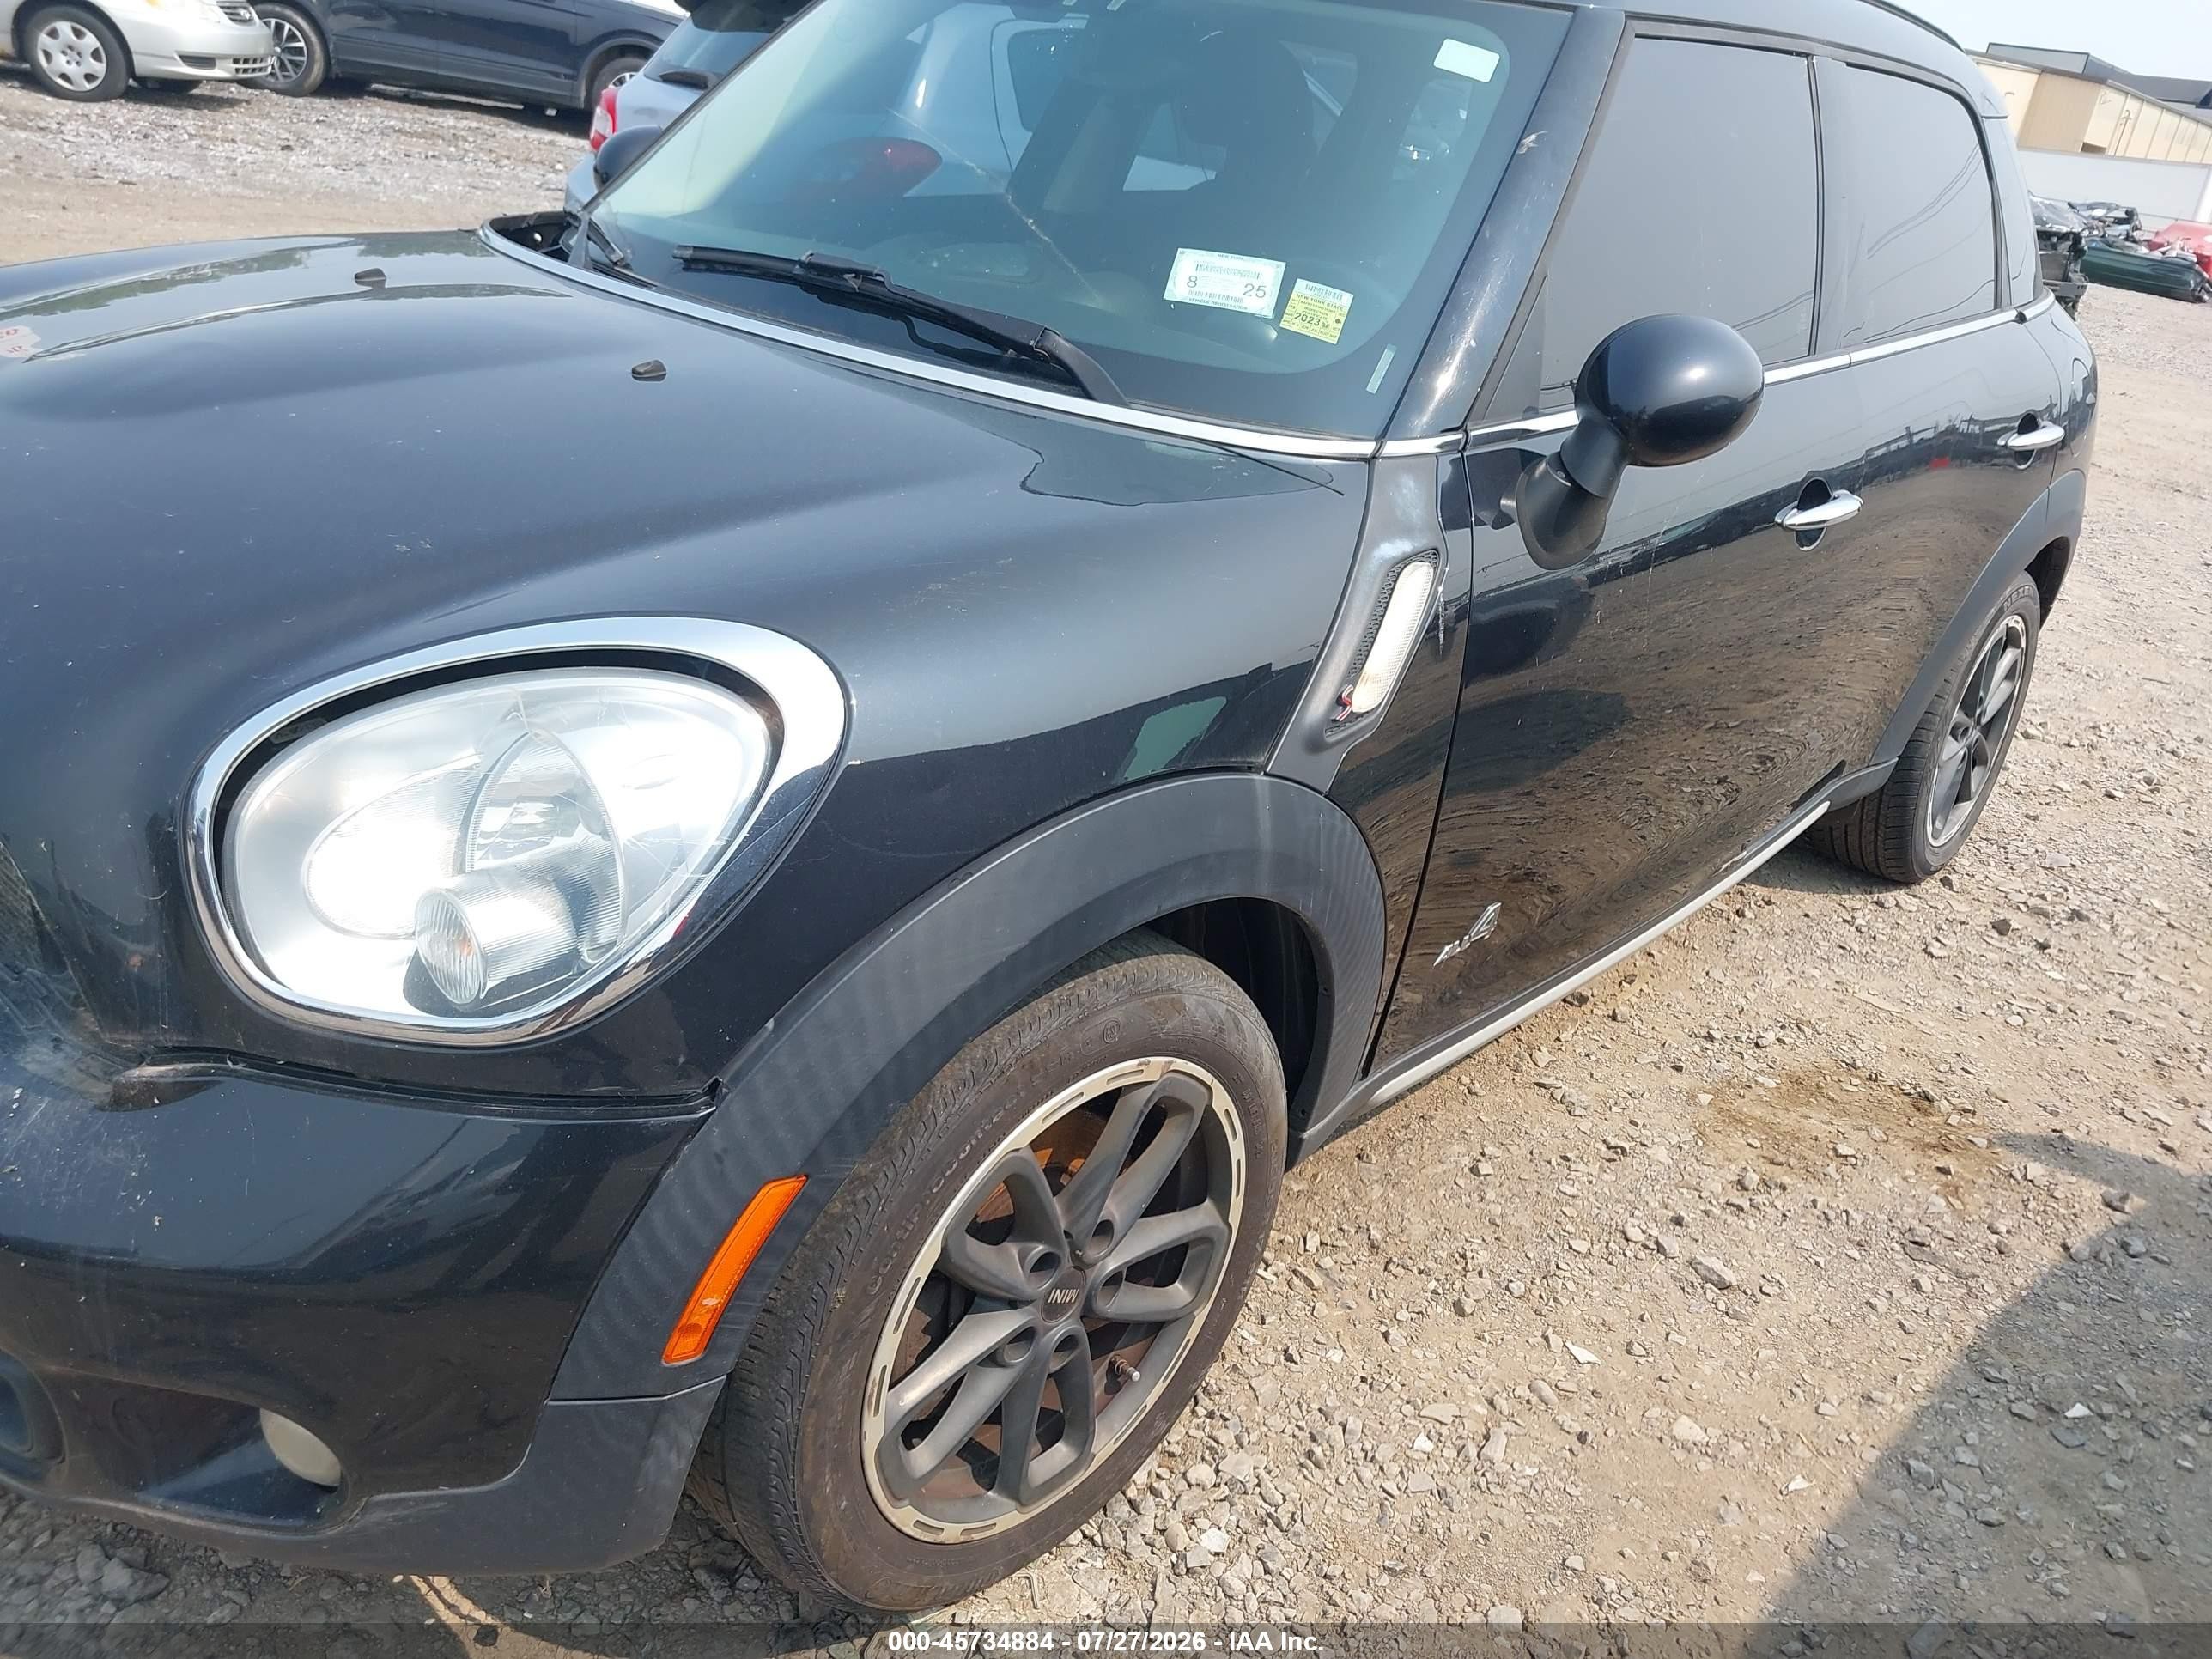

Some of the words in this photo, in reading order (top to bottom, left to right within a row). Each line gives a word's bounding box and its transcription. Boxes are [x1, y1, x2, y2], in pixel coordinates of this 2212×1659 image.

[1186, 275, 1198, 288] 8
[1243, 283, 1267, 299] 25
[1294, 312, 1321, 326] 2023
[1047, 1288, 1079, 1304] MINI
